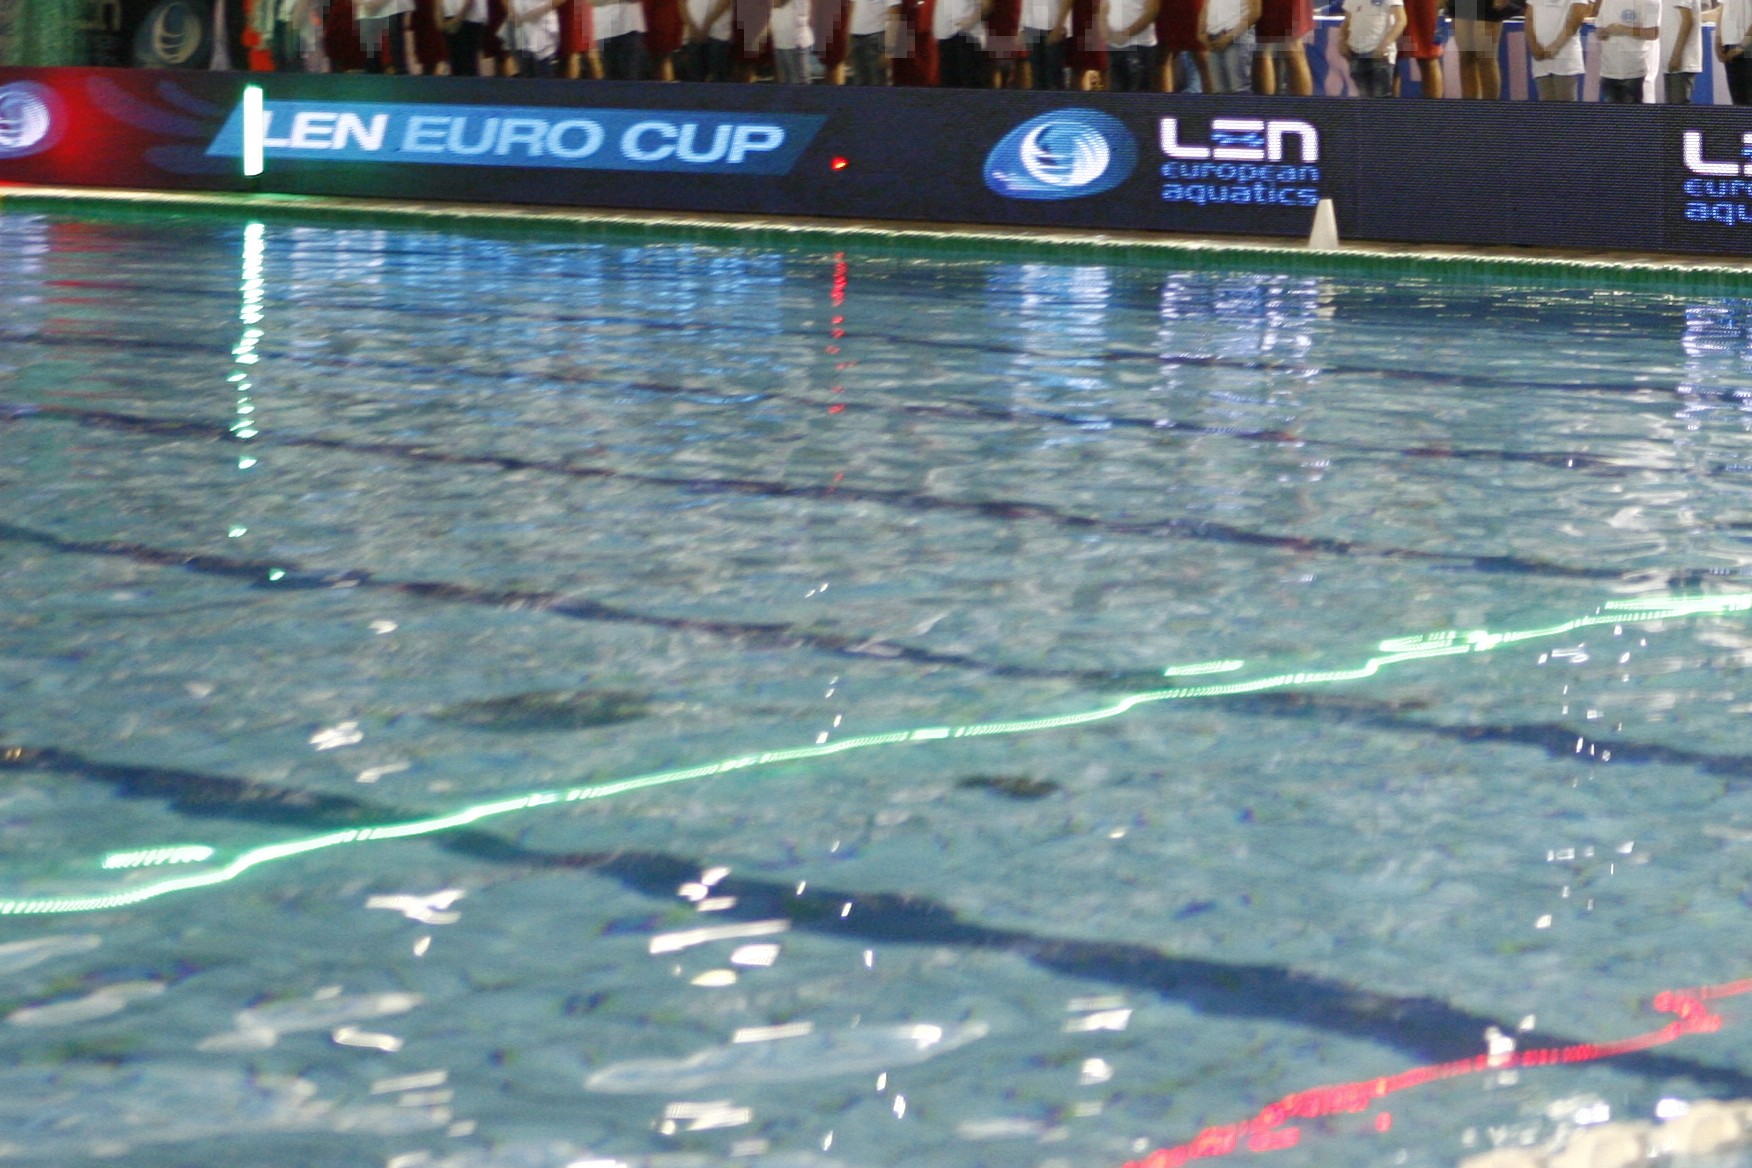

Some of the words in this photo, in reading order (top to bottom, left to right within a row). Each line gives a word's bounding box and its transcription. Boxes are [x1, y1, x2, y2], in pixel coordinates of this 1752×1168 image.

[260, 111, 388, 151] LEN
[403, 116, 603, 159] EURO
[621, 123, 784, 164] CUP
[1161, 163, 1319, 183] european
[1161, 182, 1319, 206] aquatics
